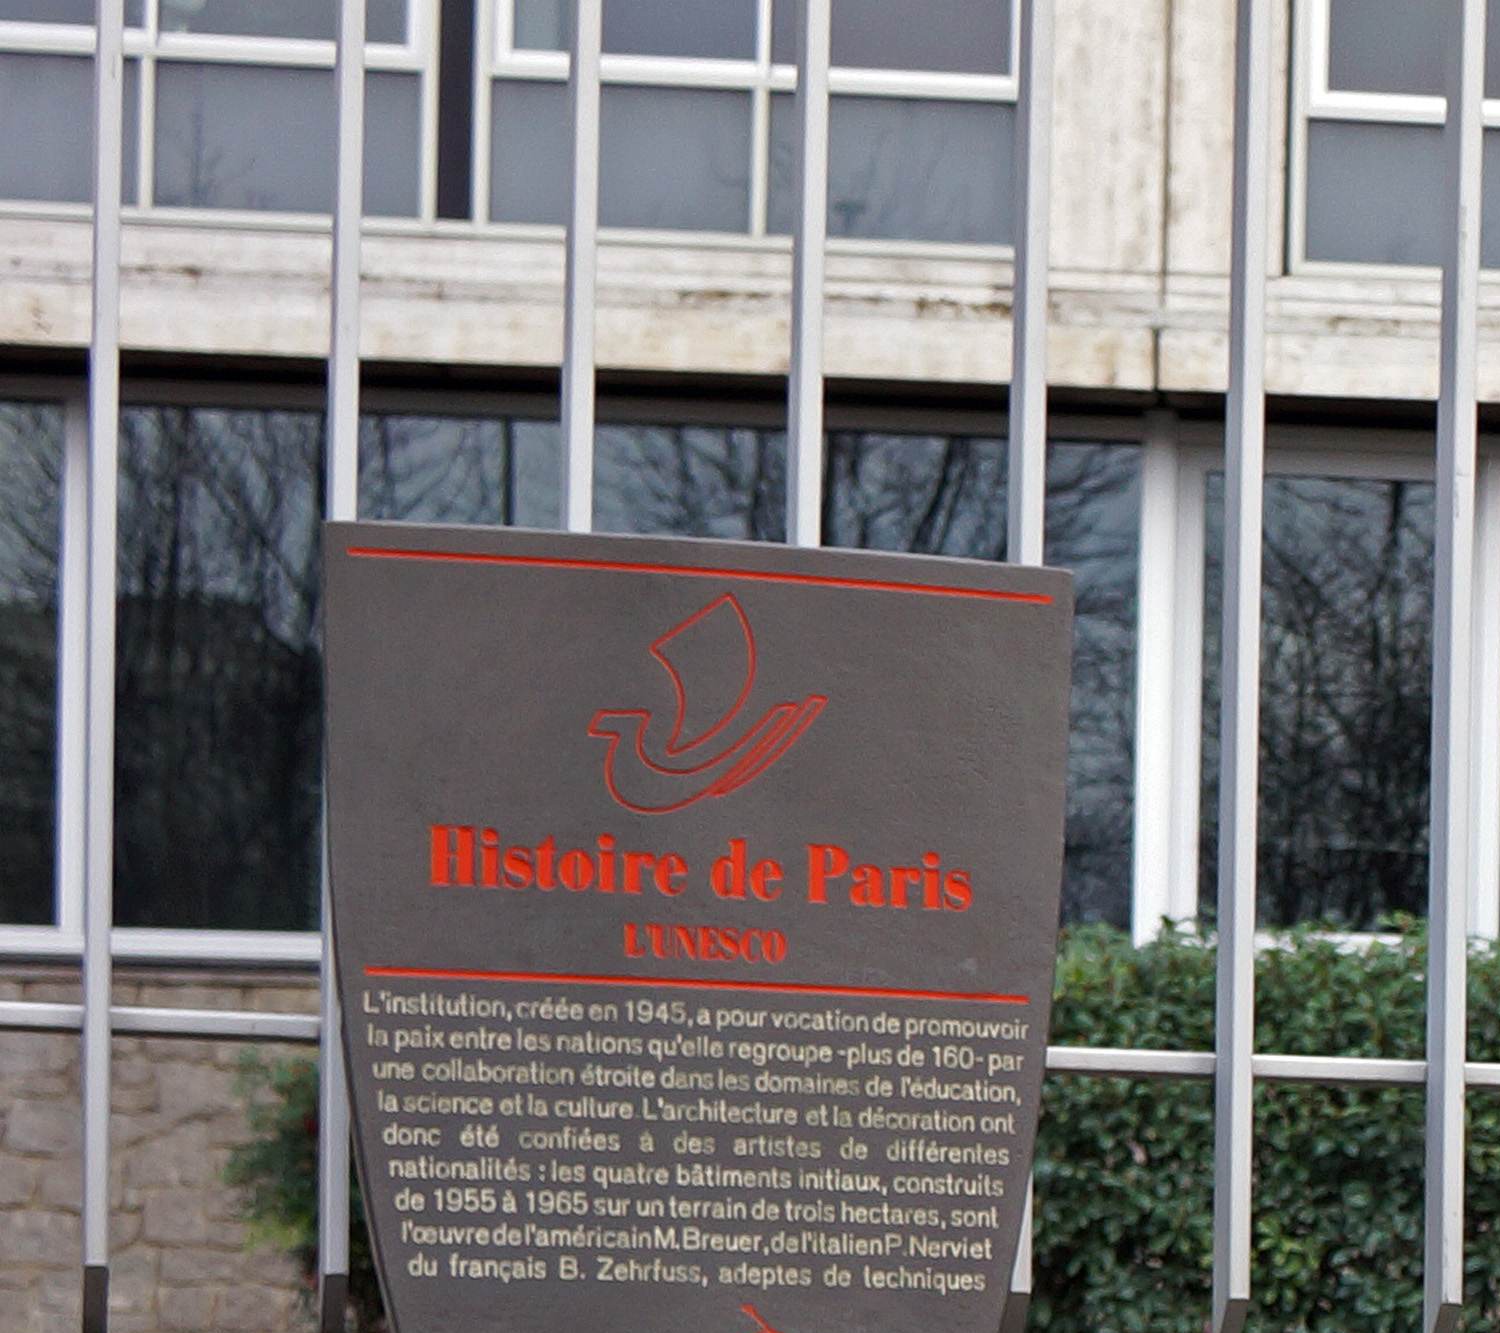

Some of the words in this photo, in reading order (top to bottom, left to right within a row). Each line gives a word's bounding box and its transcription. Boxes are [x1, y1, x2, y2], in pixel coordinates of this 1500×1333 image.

[429, 823, 689, 897] Histoire
[709, 838, 784, 901] de
[806, 843, 973, 912] Paris
[623, 922, 787, 965] L'UNESCO
[363, 991, 513, 1023] L'institution,
[515, 997, 585, 1022] créée
[588, 1003, 619, 1023] en
[624, 1000, 694, 1027] 1945,
[696, 1012, 711, 1027] a
[715, 1008, 767, 1031] pour
[772, 1009, 869, 1034] vocation
[872, 1012, 900, 1034] de
[904, 1019, 1030, 1041] promouvoir
[367, 1023, 389, 1046] la
[393, 1025, 445, 1053] paix
[449, 1028, 512, 1051] entre
[517, 1028, 551, 1051] les
[556, 1031, 643, 1055] nations
[648, 1033, 724, 1062] qu'elle
[729, 1040, 833, 1068] regroupe
[897, 1045, 925, 1068] de
[987, 1051, 1024, 1076] par
[372, 1061, 415, 1080] une
[421, 1058, 575, 1086] collaboration
[580, 1065, 655, 1088] étroite
[660, 1066, 714, 1090] dans
[717, 1068, 750, 1092] les
[754, 1071, 860, 1096] domaines
[865, 1075, 893, 1098] de
[900, 1076, 1022, 1105] l'éducation,
[377, 1089, 399, 1113] la
[402, 1092, 494, 1115] science
[499, 1093, 523, 1116] et
[527, 1093, 549, 1117] la
[642, 1098, 798, 1125] L'architecture
[805, 1104, 829, 1127] et
[833, 1104, 852, 1128] la
[858, 1106, 976, 1133] décoration
[980, 1113, 1016, 1136] ont
[382, 1123, 441, 1147] donc
[459, 1124, 500, 1148] été
[518, 1125, 621, 1151] confiées
[639, 1130, 654, 1153] à
[673, 1131, 715, 1154] des
[733, 1133, 822, 1158] artistes
[839, 1137, 868, 1159] de
[886, 1138, 1010, 1166] différentes
[388, 1155, 531, 1181] nationalités
[551, 1159, 586, 1183] les
[592, 1162, 669, 1189] quatre
[676, 1162, 791, 1189] bâtiments
[799, 1168, 888, 1196] initiaux,
[893, 1171, 1004, 1197] construits
[394, 1187, 425, 1212] de
[433, 1188, 497, 1213] 1955
[502, 1189, 517, 1214] à
[525, 1190, 589, 1215] 1965
[593, 1195, 630, 1217] sur
[635, 1198, 664, 1218] un
[669, 1194, 747, 1220] terrain
[750, 1199, 780, 1221] de
[785, 1200, 836, 1223] trois
[840, 1202, 946, 1229] hectares,
[950, 1206, 999, 1229] sont
[401, 1219, 490, 1246] l'œuvre
[491, 1222, 523, 1246] de
[525, 1223, 651, 1249] l'américain
[770, 1231, 799, 1254] de
[800, 1231, 883, 1256] l'italien
[970, 1238, 993, 1260] et
[407, 1252, 438, 1278] du
[449, 1252, 547, 1284] français
[559, 1255, 587, 1280] B.
[596, 1257, 708, 1287] Zehrfuss,
[718, 1262, 812, 1290] adeptes
[823, 1263, 851, 1287] de
[864, 1265, 986, 1295] techniques
